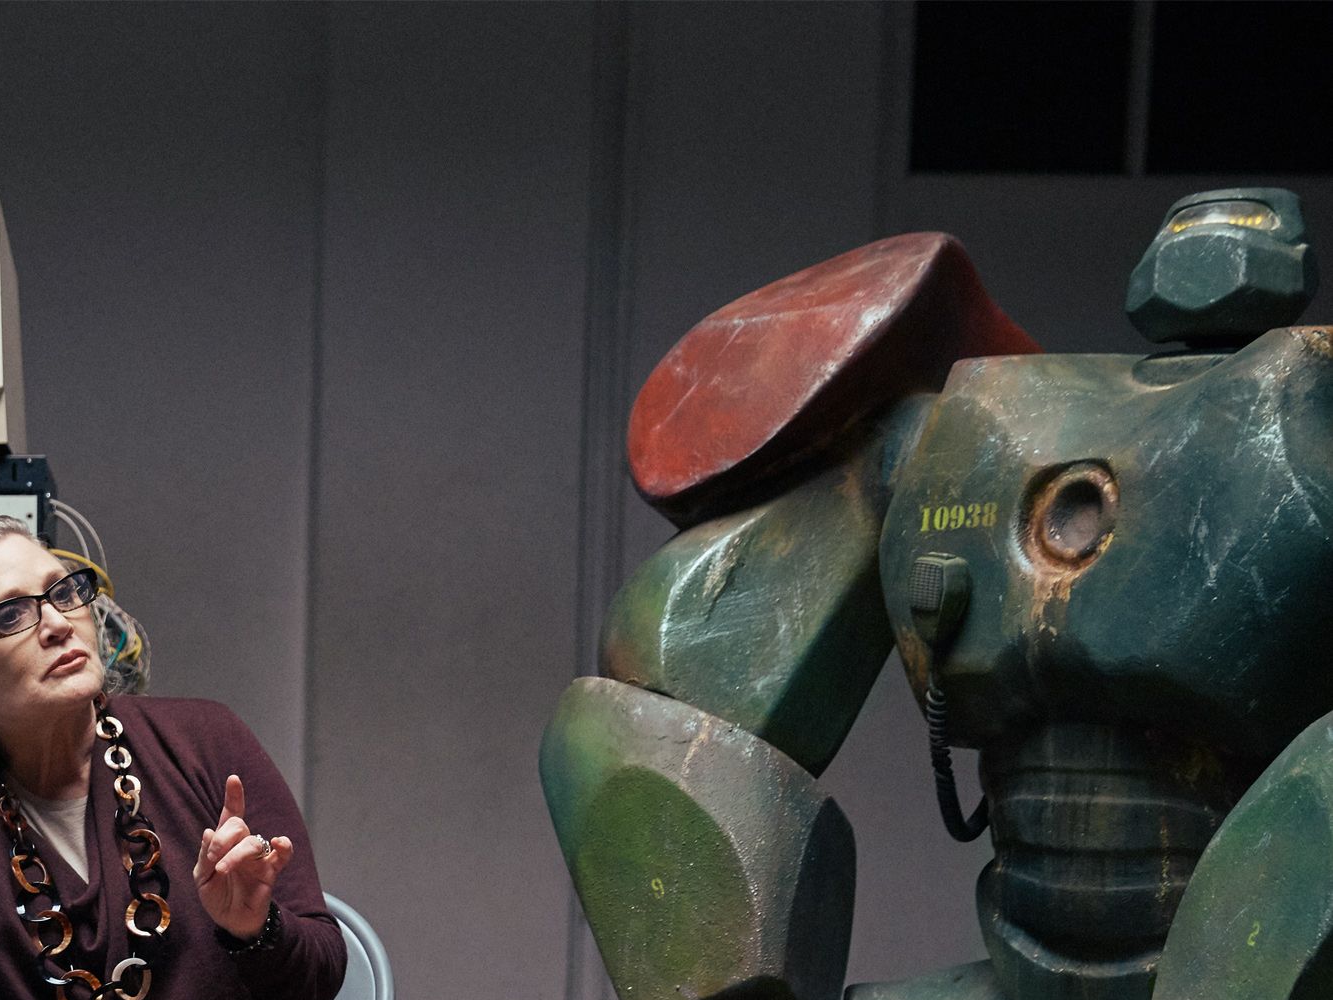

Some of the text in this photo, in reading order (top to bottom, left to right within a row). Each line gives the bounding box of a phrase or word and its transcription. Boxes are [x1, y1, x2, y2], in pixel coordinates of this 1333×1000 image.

[920, 502, 998, 532] 10938
[651, 878, 665, 899] 9
[1247, 920, 1260, 946] 2
